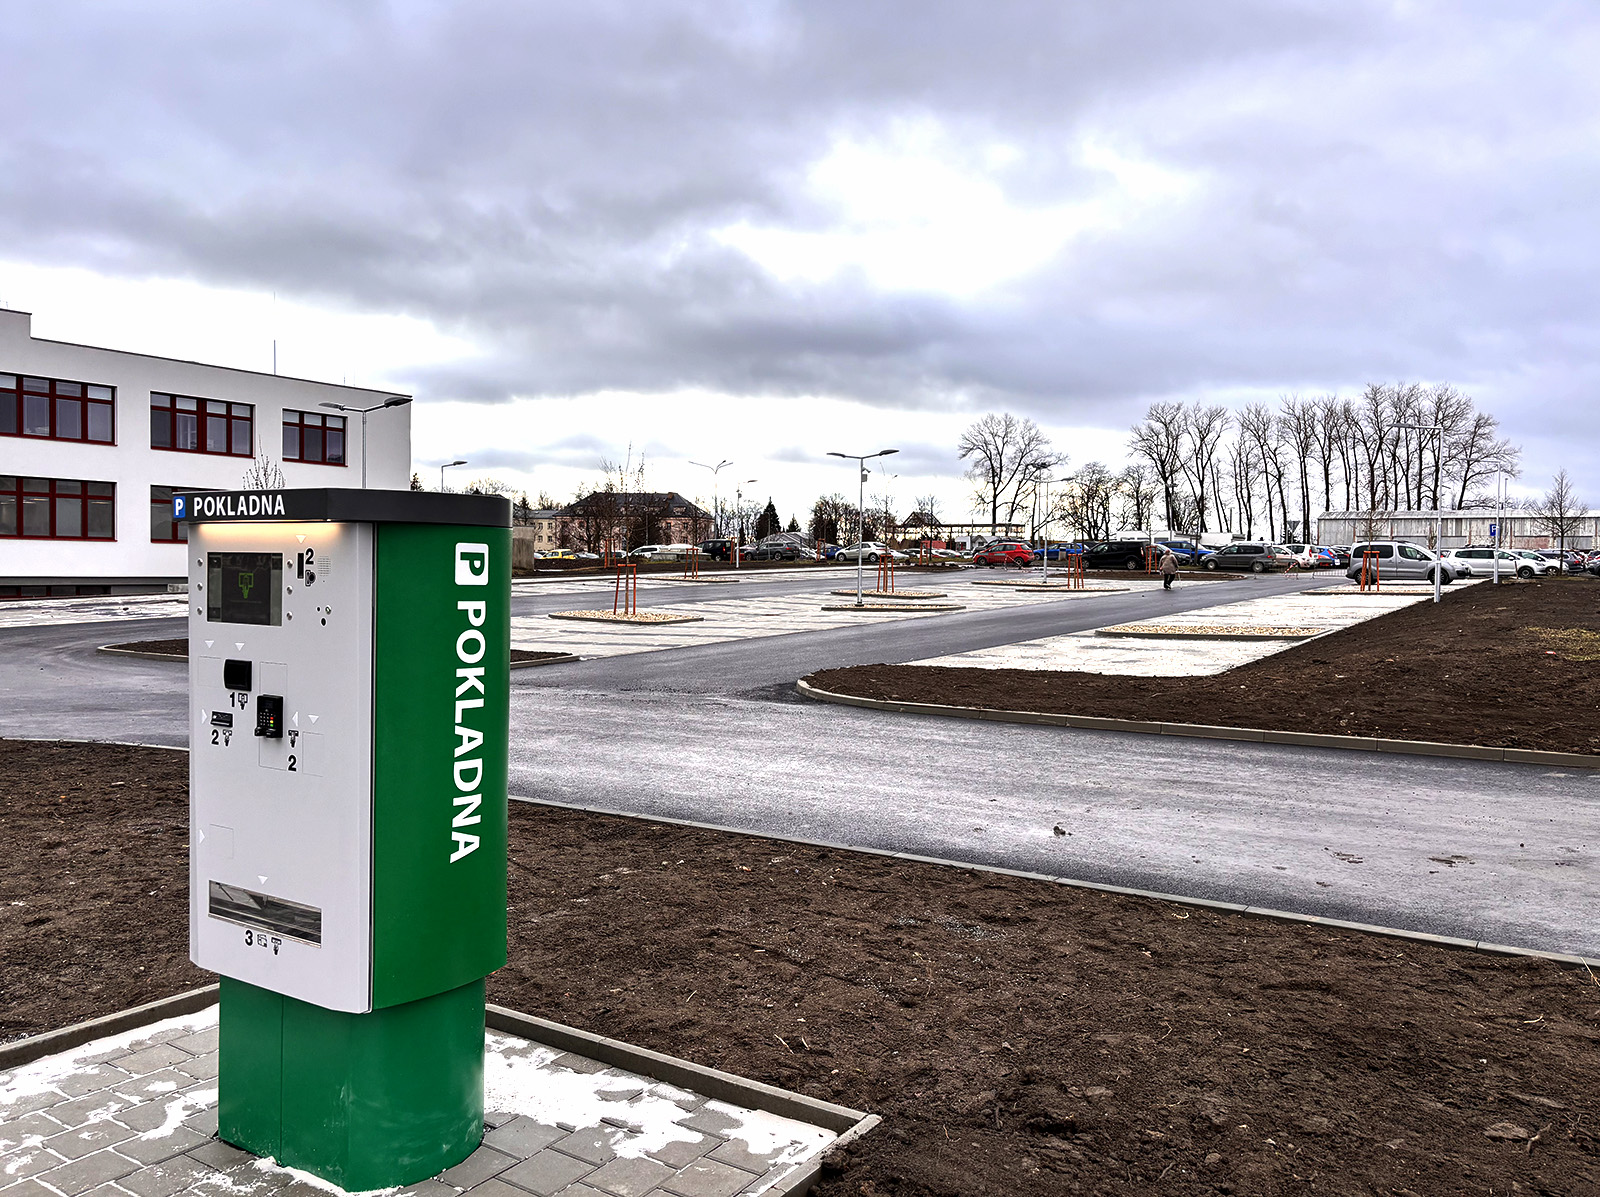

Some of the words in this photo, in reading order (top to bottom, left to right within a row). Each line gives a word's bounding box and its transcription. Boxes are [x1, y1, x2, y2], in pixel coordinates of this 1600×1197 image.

[175, 498, 184, 516] P
[193, 494, 286, 517] POKLADNA
[305, 547, 314, 565] 2
[459, 551, 485, 578] P
[229, 692, 235, 708] 1
[211, 729, 219, 746] 2
[449, 600, 487, 864] POKLADNA
[288, 754, 297, 772] 2
[244, 929, 253, 947] 3
